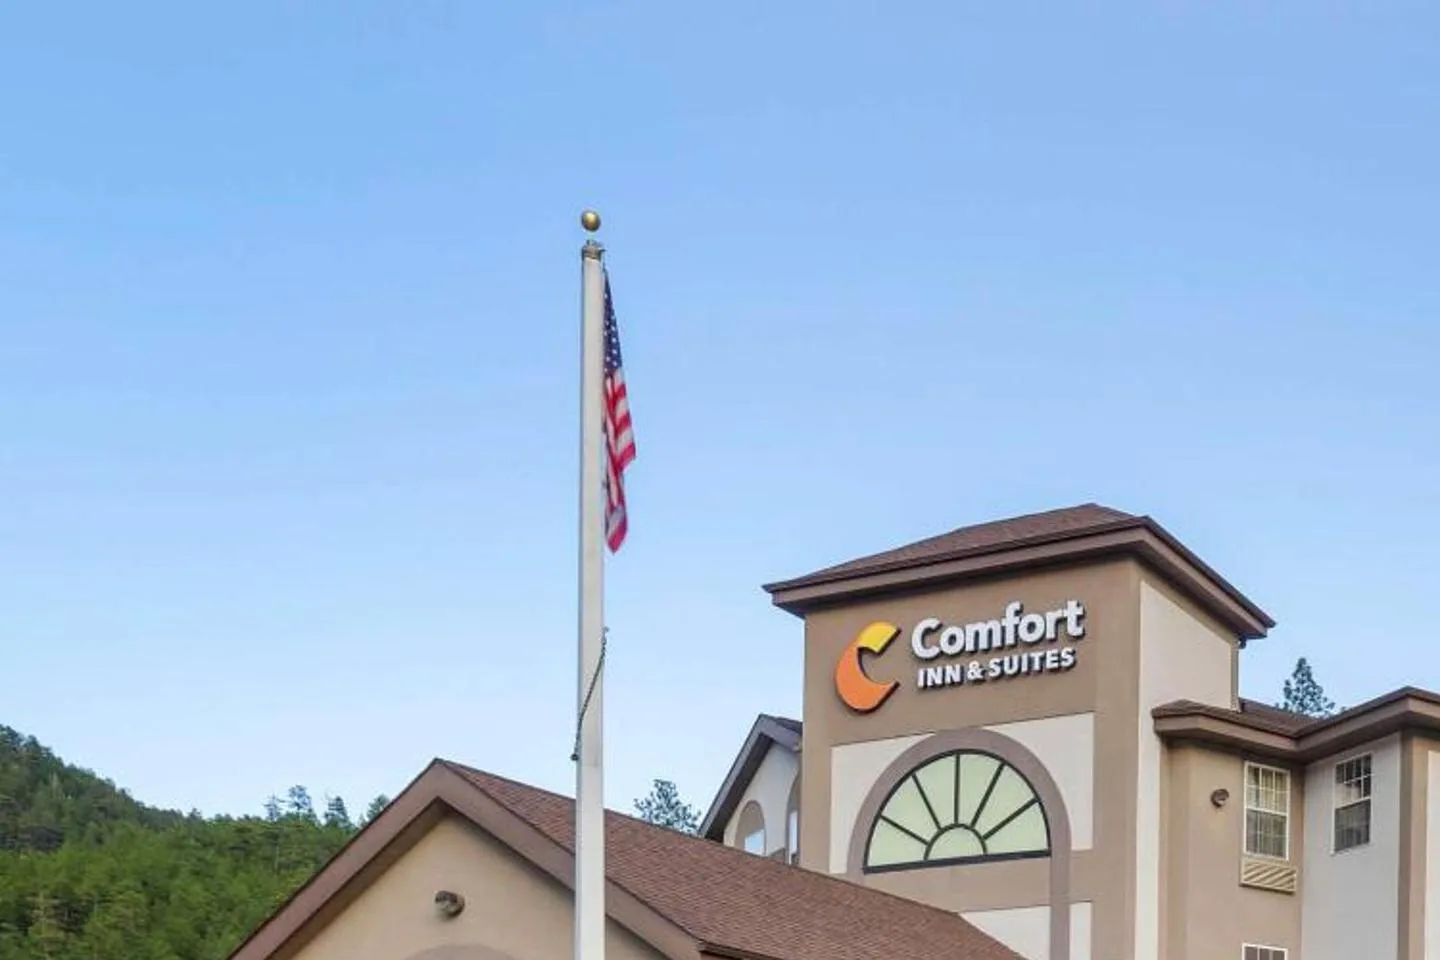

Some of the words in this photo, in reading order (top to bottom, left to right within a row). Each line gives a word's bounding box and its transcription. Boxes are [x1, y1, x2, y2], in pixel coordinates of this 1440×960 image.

[911, 600, 1085, 659] Comfort
[917, 664, 961, 688] INN
[966, 660, 985, 681] &
[987, 647, 1076, 678] SUITES
